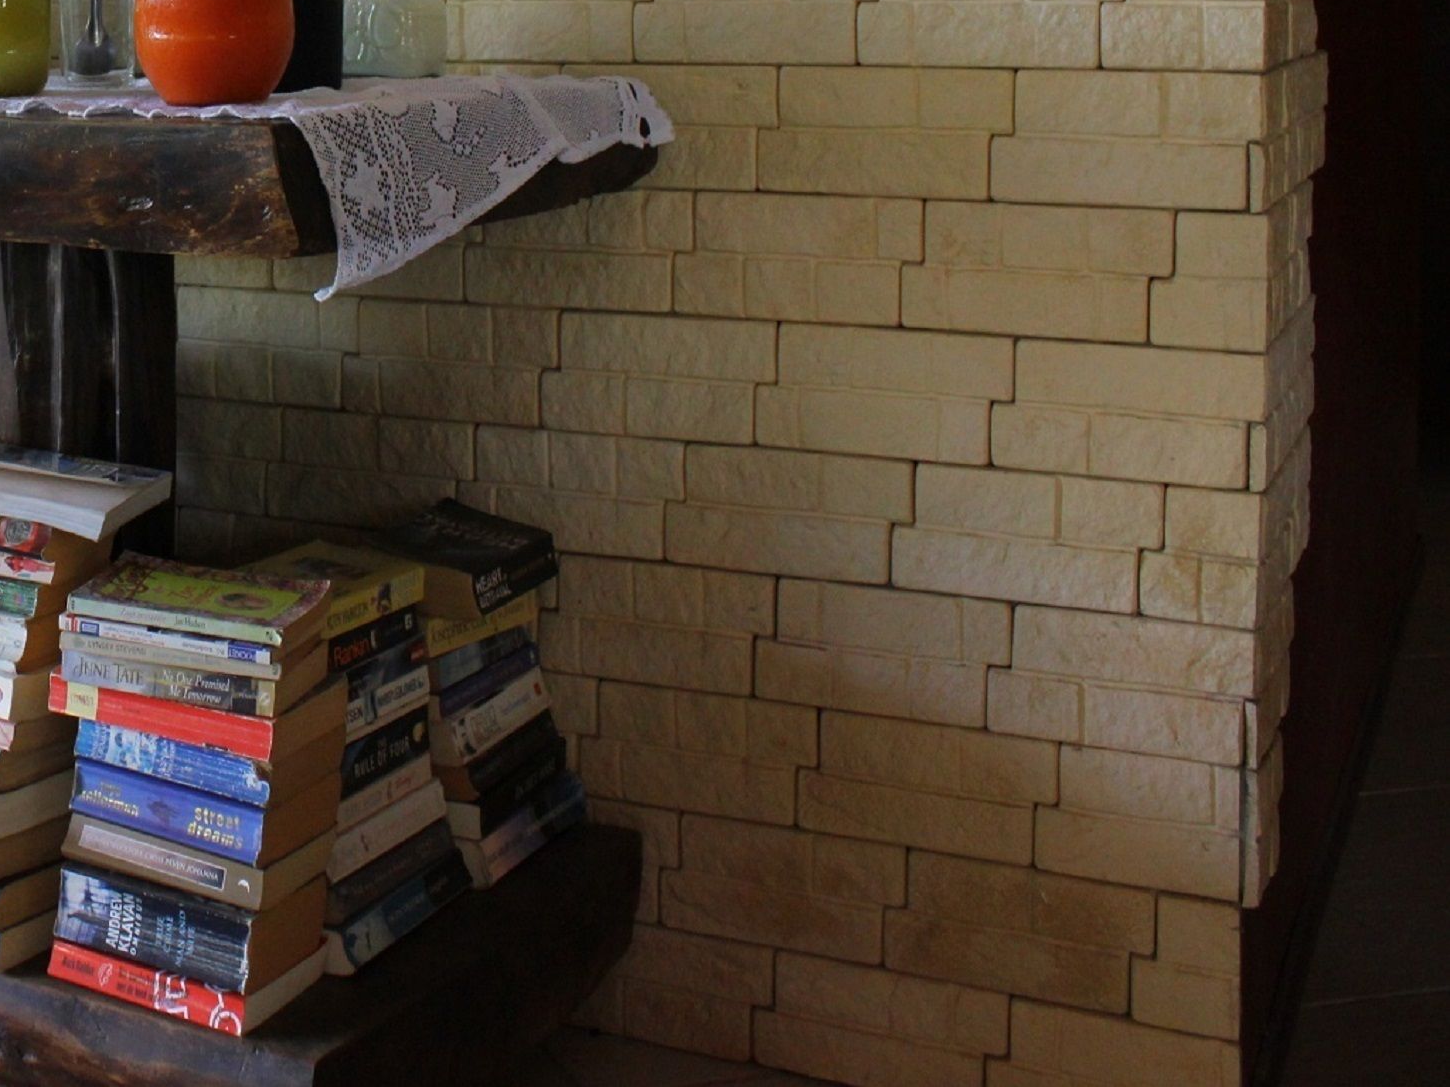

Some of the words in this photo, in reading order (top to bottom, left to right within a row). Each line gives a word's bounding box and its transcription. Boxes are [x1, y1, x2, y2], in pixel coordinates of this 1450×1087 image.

[114, 662, 144, 684] TATE
[175, 672, 193, 687] One
[194, 674, 231, 693] Promised
[193, 806, 242, 829] street
[186, 821, 244, 850] dreams
[105, 890, 124, 949] ANDREW
[116, 892, 136, 953] KLAVAN
